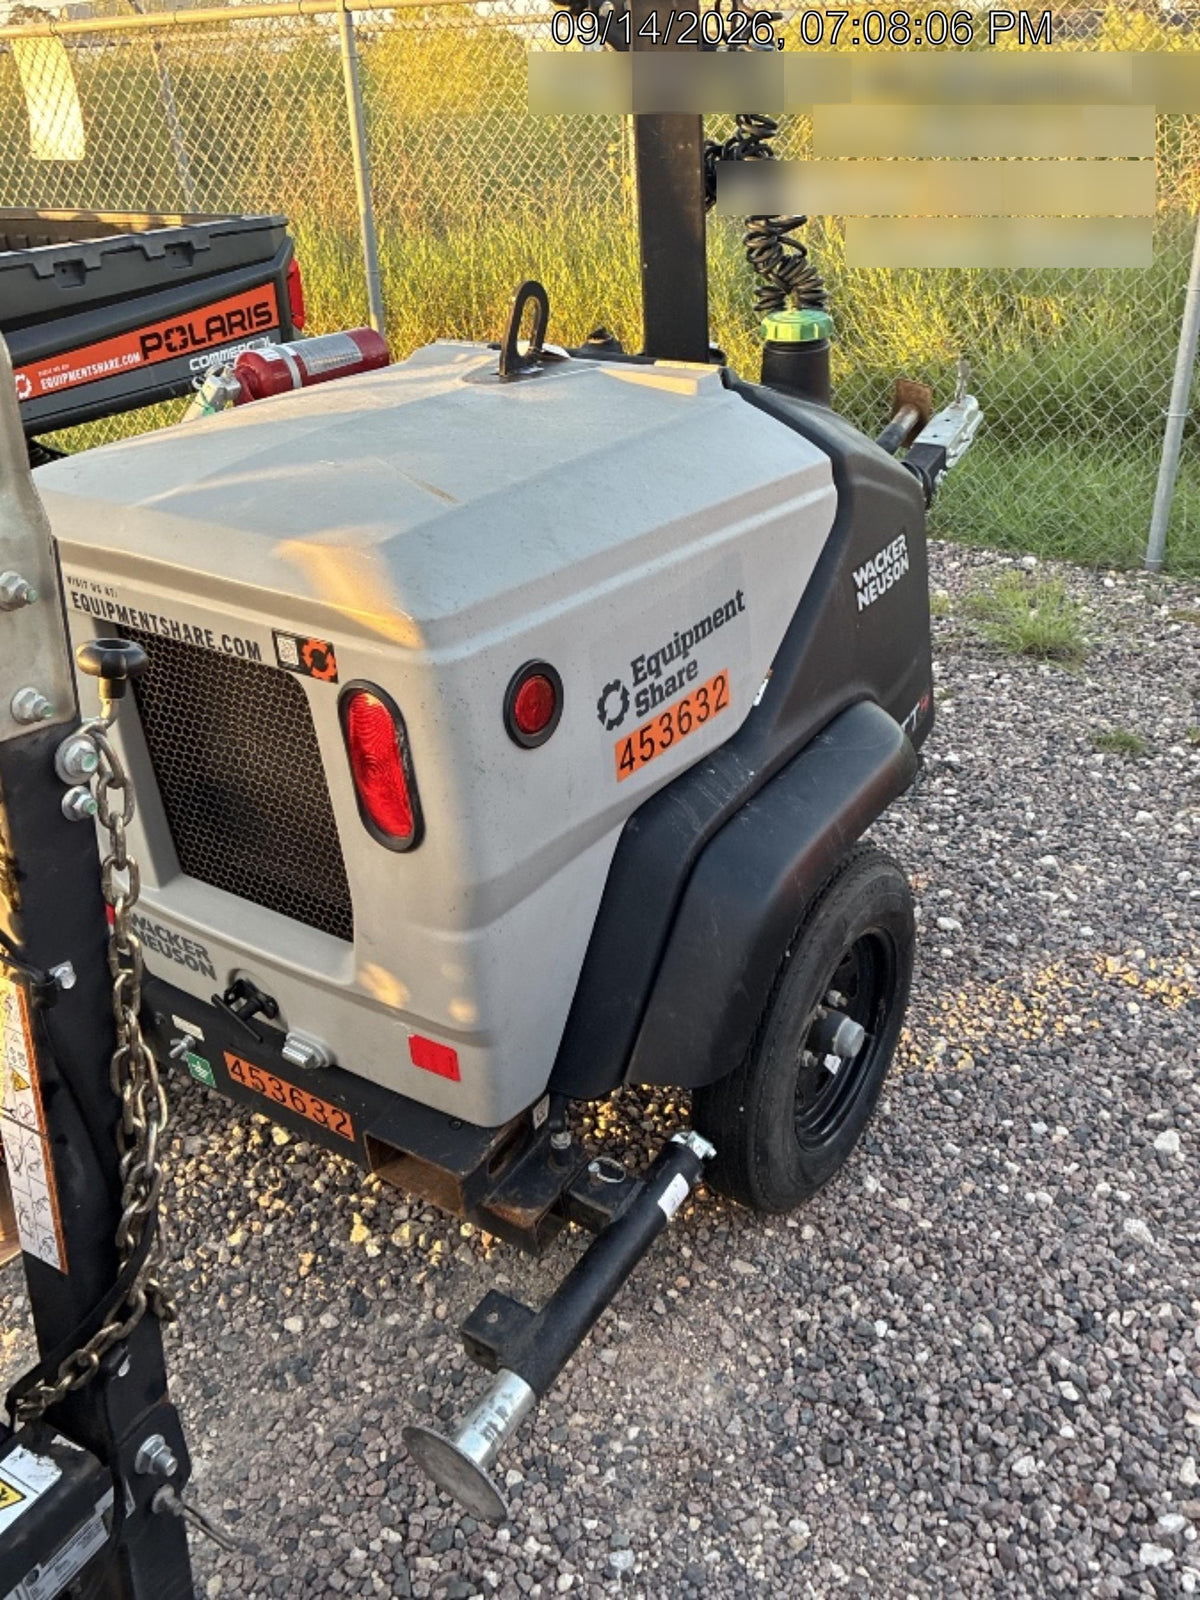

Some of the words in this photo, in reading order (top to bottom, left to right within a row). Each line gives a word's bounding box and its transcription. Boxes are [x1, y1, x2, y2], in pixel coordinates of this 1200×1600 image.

[140, 301, 273, 361] POLARIS
[40, 352, 141, 390] EQUIPMENTSHARE.COM
[852, 533, 908, 588] WACKER
[856, 552, 910, 612] NEUSON
[71, 590, 263, 662] EQUIPMENTSHARE.COM
[630, 589, 746, 687] Equipment
[634, 659, 699, 718] Share
[619, 674, 728, 772] 453632
[230, 1059, 351, 1138] 453632
